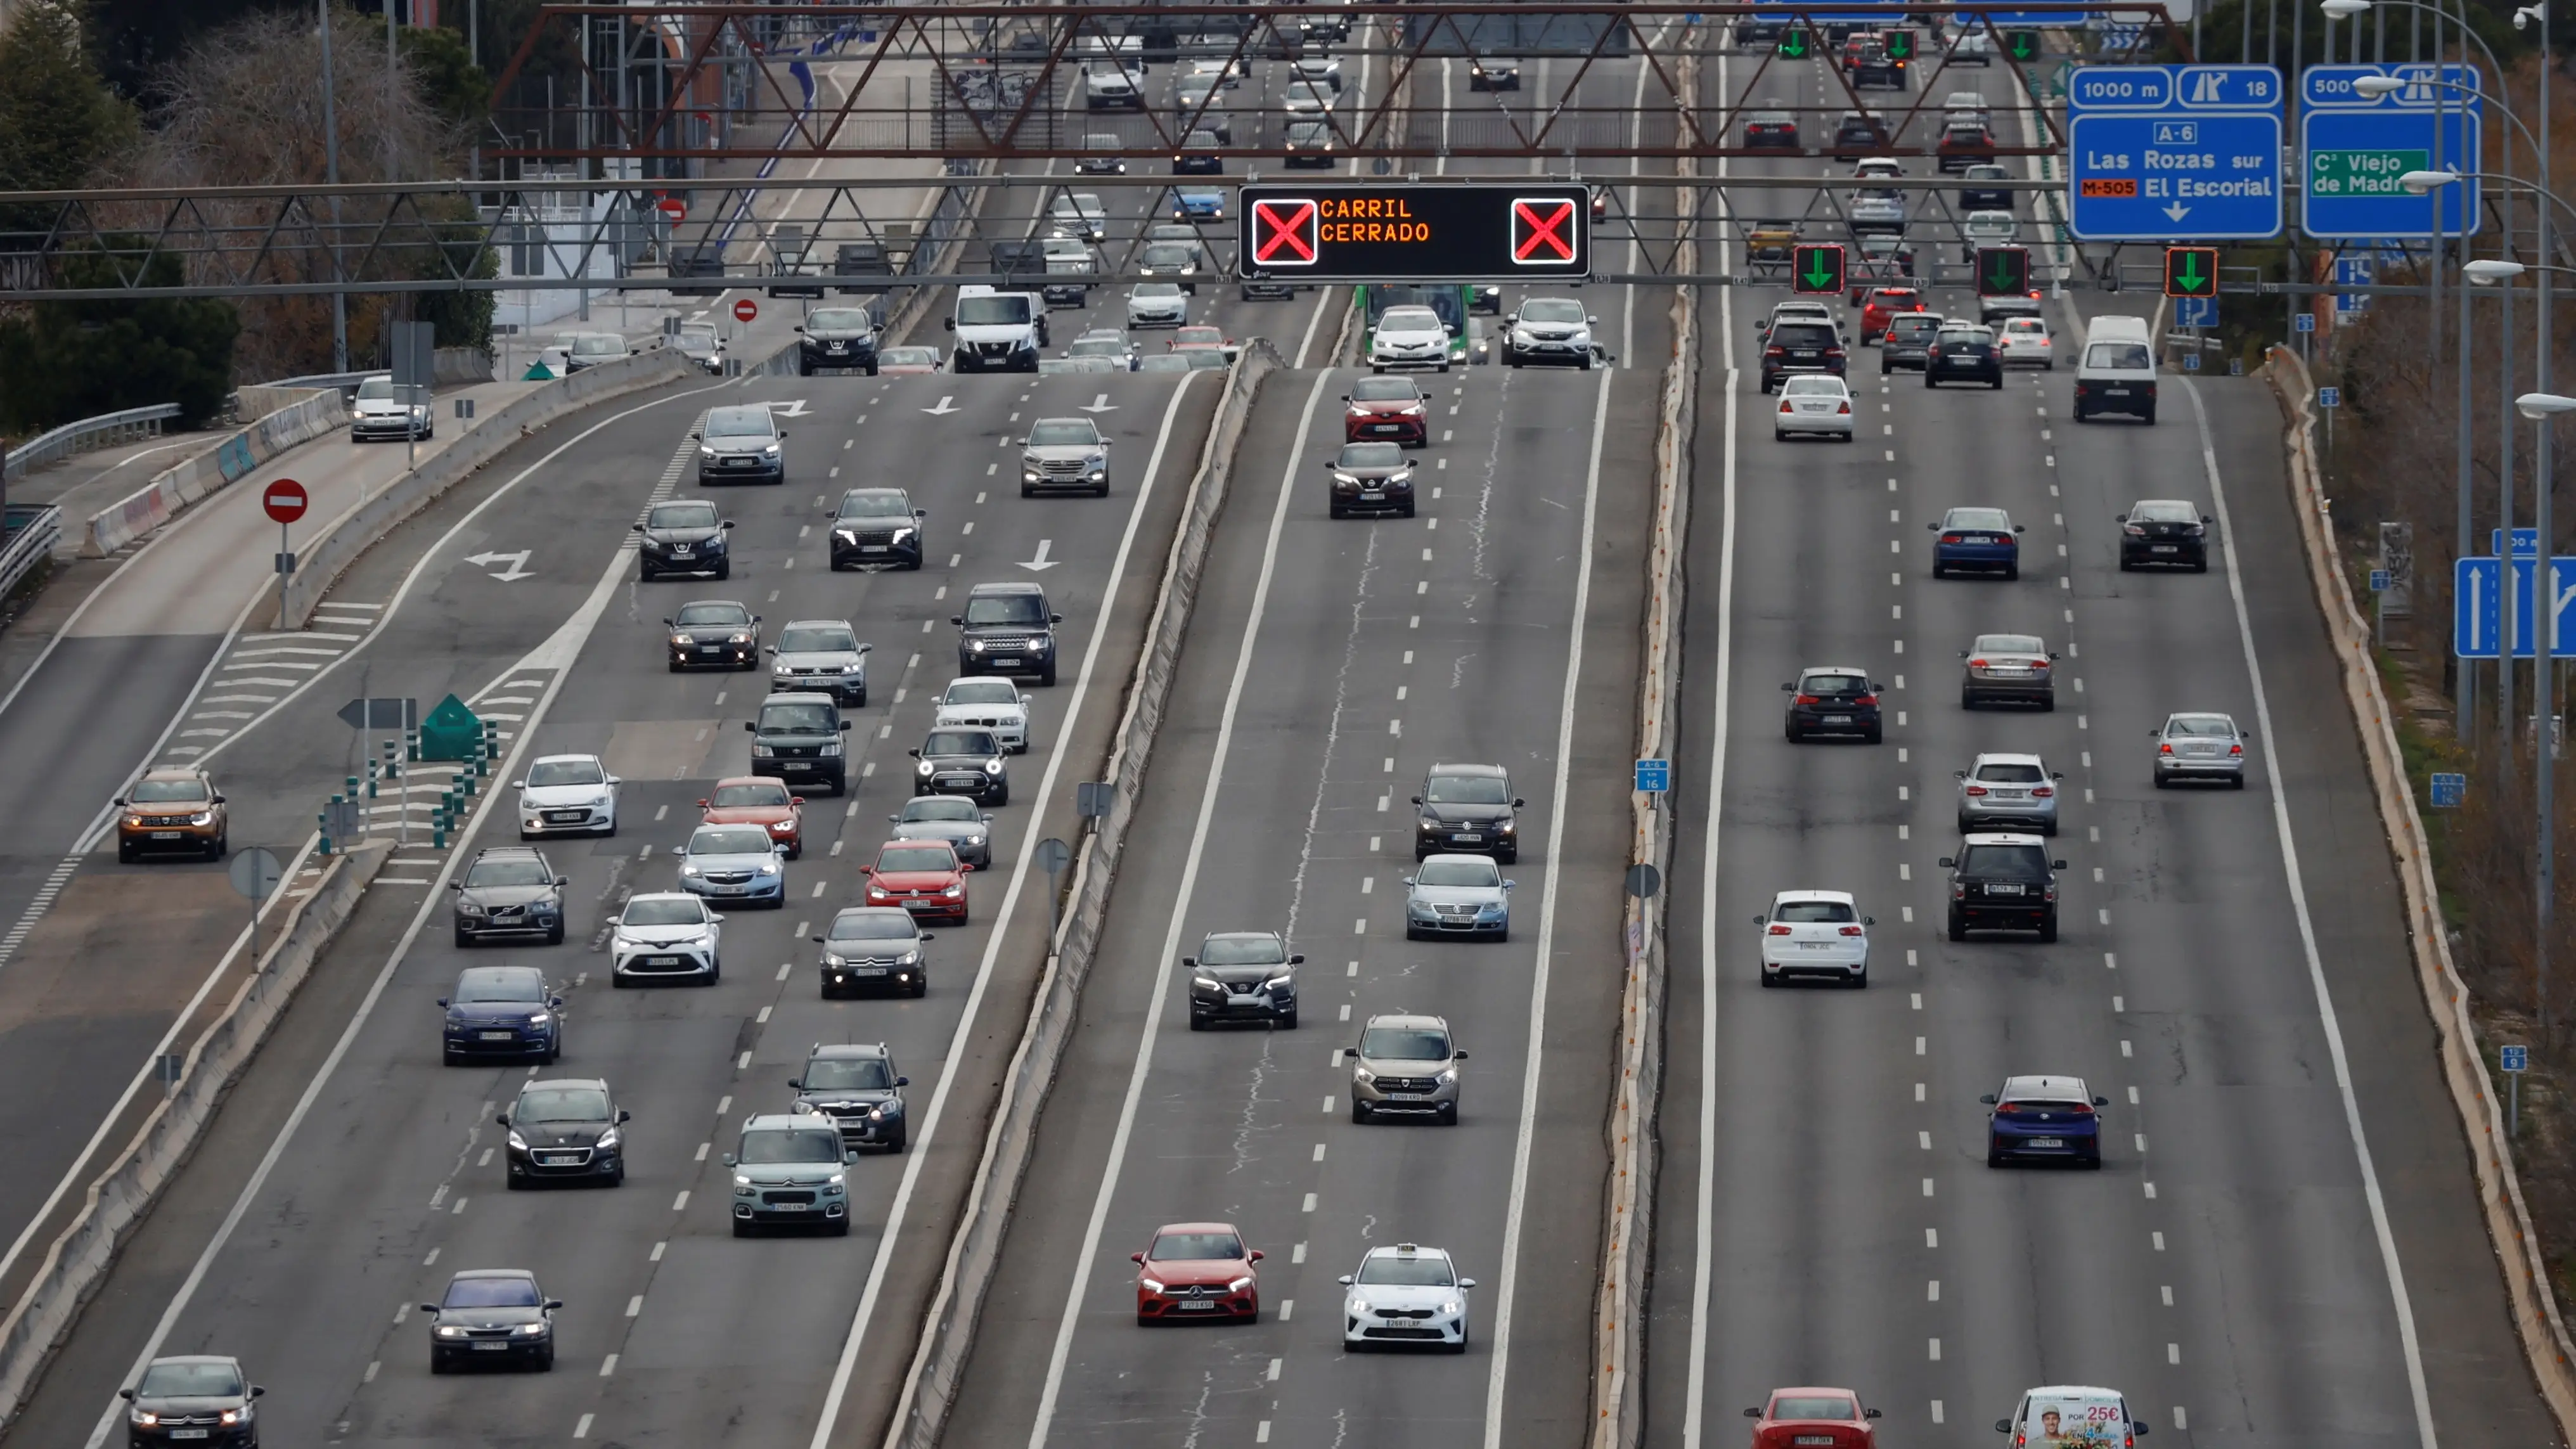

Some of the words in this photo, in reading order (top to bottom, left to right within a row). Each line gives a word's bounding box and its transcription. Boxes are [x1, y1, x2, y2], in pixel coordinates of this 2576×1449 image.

[2083, 82, 2133, 98] 1000
[2142, 85, 2158, 97] m
[2246, 81, 2267, 96] 18
[2315, 79, 2350, 93] 500
[2158, 126, 2193, 141] A-6
[2088, 150, 2130, 170] Las
[2144, 150, 2215, 169] Rozas
[2231, 155, 2264, 169] sur
[2348, 154, 2402, 174] Viejo
[2082, 181, 2135, 195] M-505
[2145, 177, 2170, 197] El
[2177, 177, 2272, 197] Escorial
[2314, 176, 2340, 192] de
[2348, 176, 2402, 192] Madr
[1320, 199, 1412, 217] CARRIL
[1320, 223, 1429, 242] CERRADO
[2506, 537, 2526, 546] 00
[1647, 780, 1659, 789] 16
[2510, 1058, 2518, 1068] 9
[2087, 1407, 2119, 1421] 25€
[2085, 1427, 2095, 1439] 4
